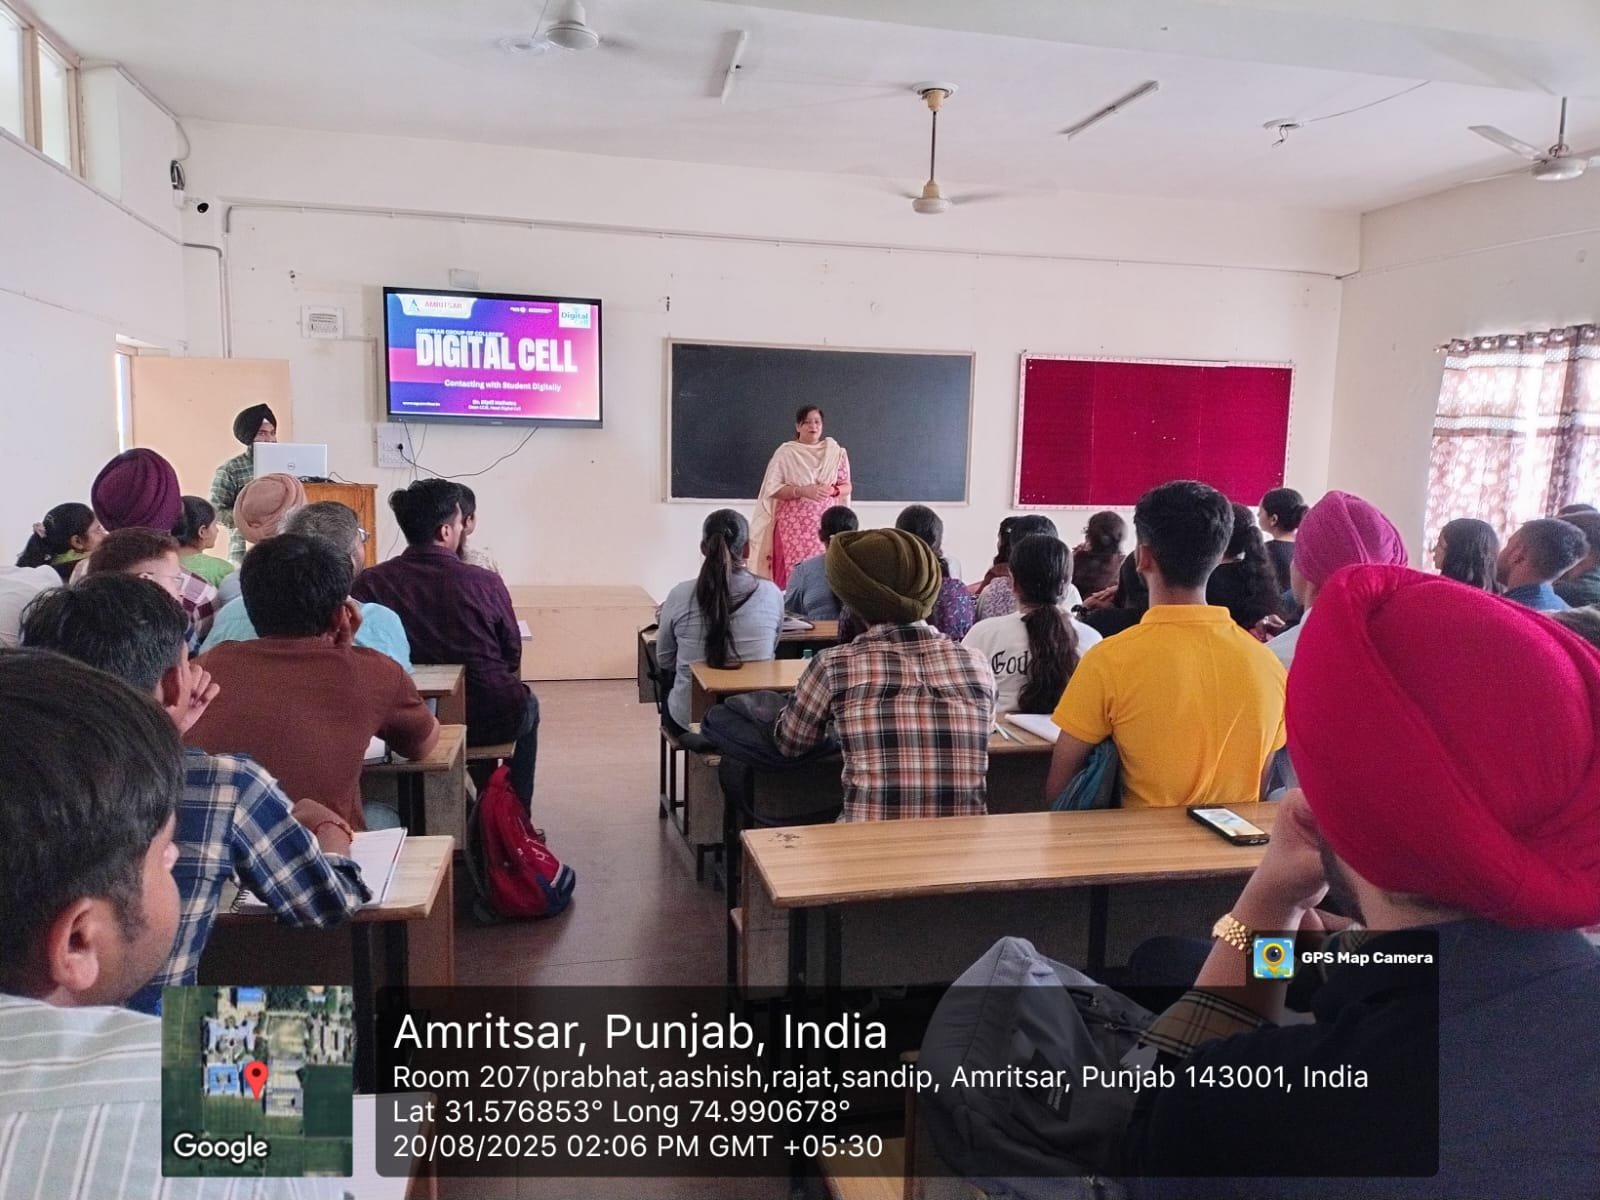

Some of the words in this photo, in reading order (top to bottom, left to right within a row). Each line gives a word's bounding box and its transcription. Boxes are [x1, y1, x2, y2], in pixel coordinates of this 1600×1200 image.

[561, 311, 588, 321] Digital
[416, 333, 516, 370] DIGITAL
[518, 337, 578, 373] CELL
[444, 379, 485, 390] Contacting
[486, 381, 502, 389] with
[503, 381, 531, 390] Student
[532, 382, 561, 393] Digitally
[991, 649, 1029, 676] God
